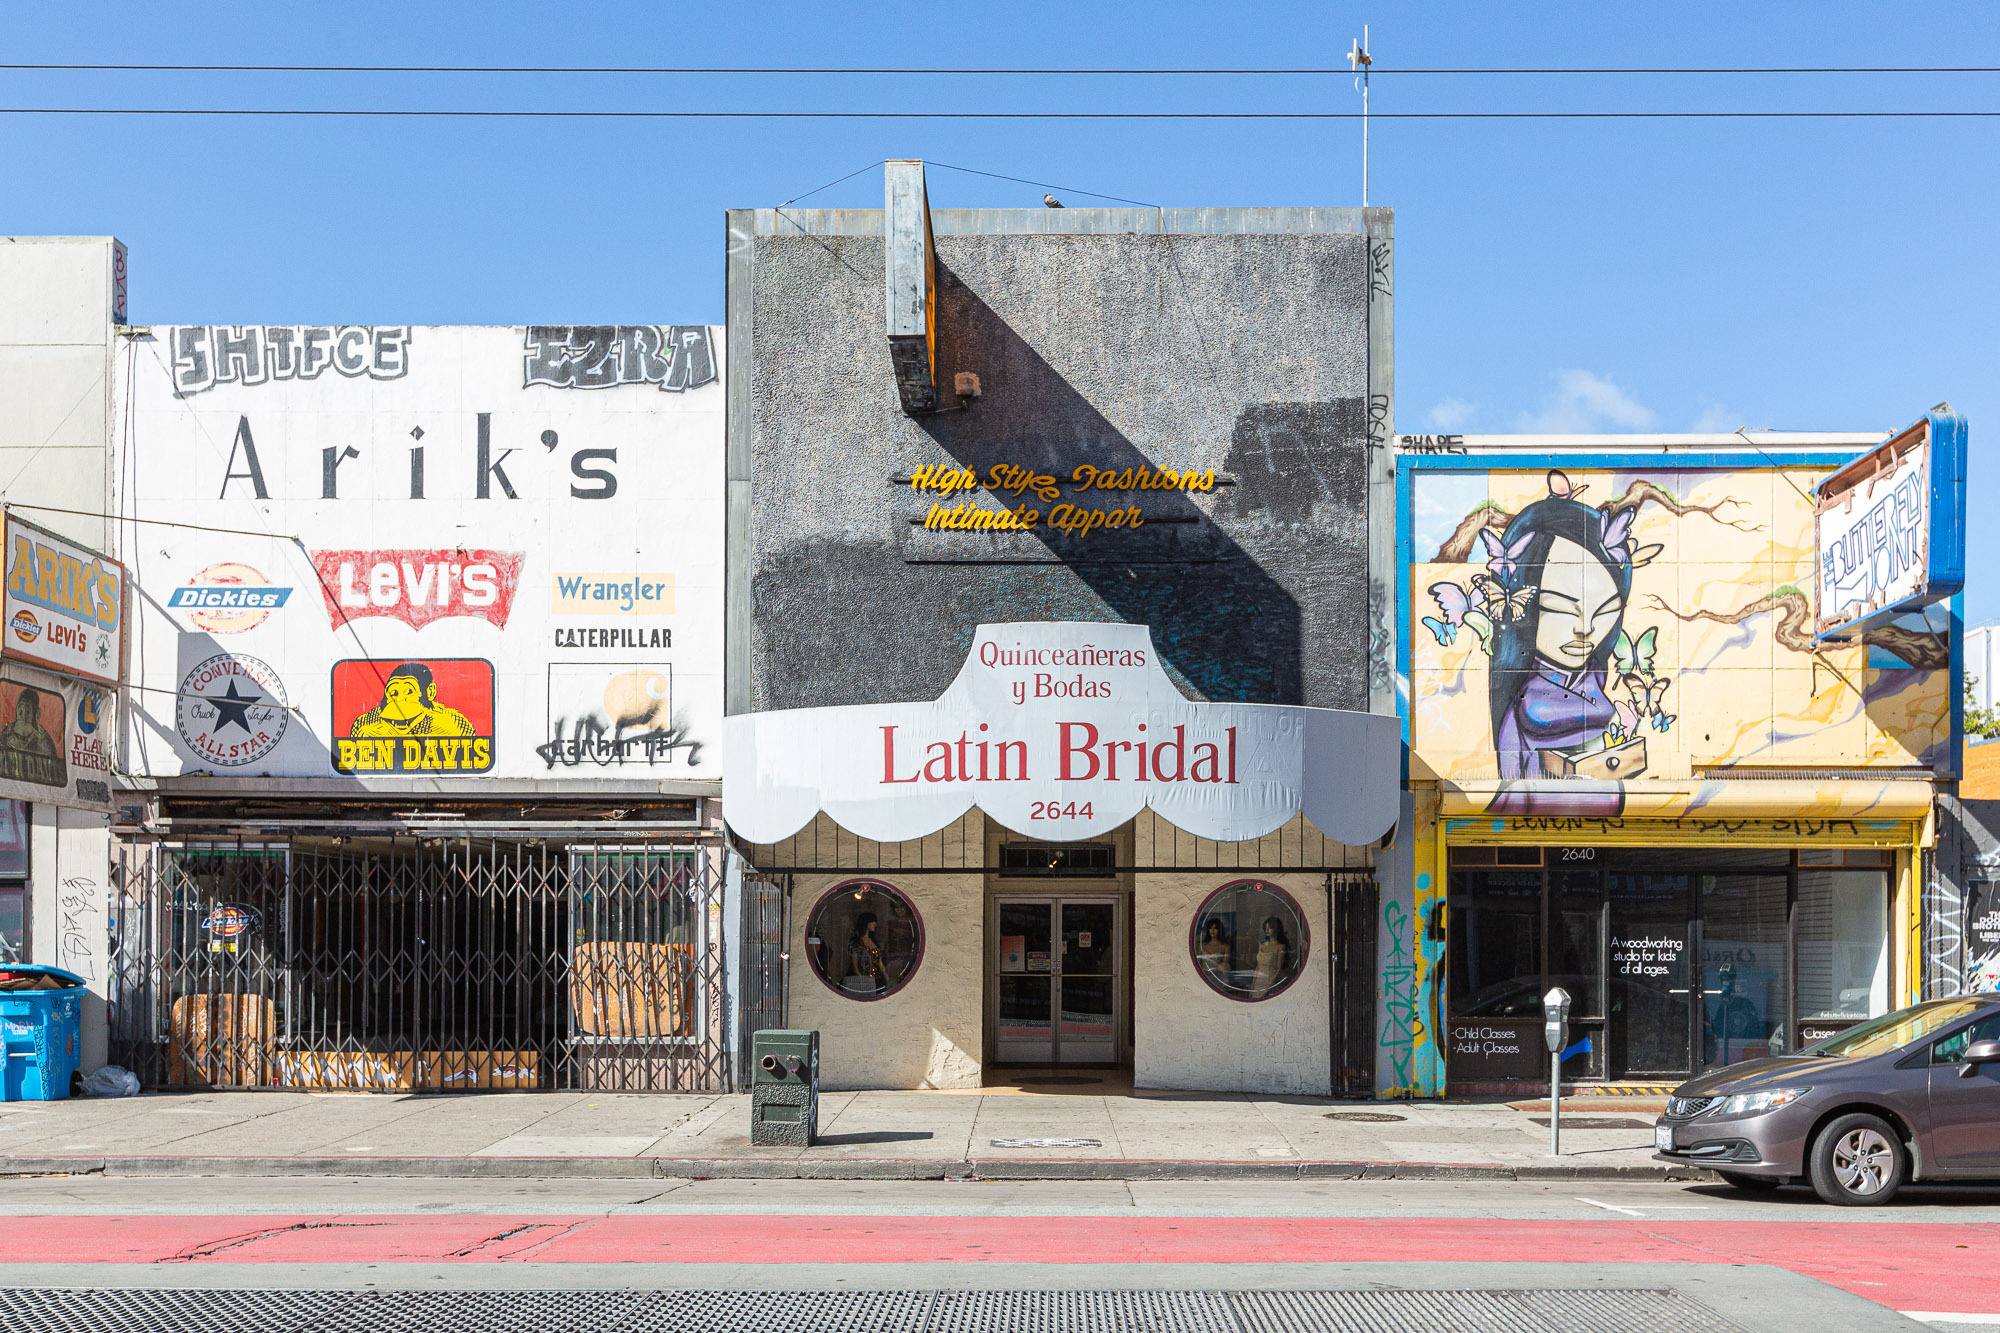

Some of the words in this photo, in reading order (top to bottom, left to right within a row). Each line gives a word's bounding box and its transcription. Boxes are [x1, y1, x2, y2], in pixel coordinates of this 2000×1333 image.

[219, 412, 618, 499] Arik's
[911, 463, 976, 497] High
[1072, 463, 1215, 493] Fashions
[924, 502, 1037, 532] Intimate
[1047, 503, 1144, 539] Appar
[7, 535, 118, 625] ARIK'S
[178, 588, 279, 607] Dickies
[557, 576, 666, 612] Wrangler
[554, 628, 672, 649] CATERPILLAR
[979, 641, 1146, 668] Quinceañeras
[1011, 683, 1026, 705] y
[1033, 673, 1112, 699] Bodas
[73, 734, 103, 756] PLAY
[338, 740, 395, 770] BEN
[402, 740, 491, 771] DAVIS
[879, 723, 1031, 784] Latin
[1054, 722, 1240, 784] Bridal
[70, 750, 108, 772] HERE
[1030, 802, 1094, 821] 2644
[1561, 848, 1596, 861] 2640
[1610, 936, 1620, 948] A
[1620, 935, 1683, 951] woodworking
[1613, 949, 1641, 962] studio
[1642, 949, 1655, 962] for
[1657, 949, 1677, 962] kids
[1620, 962, 1631, 974] of
[1632, 962, 1642, 974] all
[1643, 966, 1670, 977] ages.
[1480, 1027, 1516, 1040] Classes
[1483, 1041, 1520, 1054] Classes
